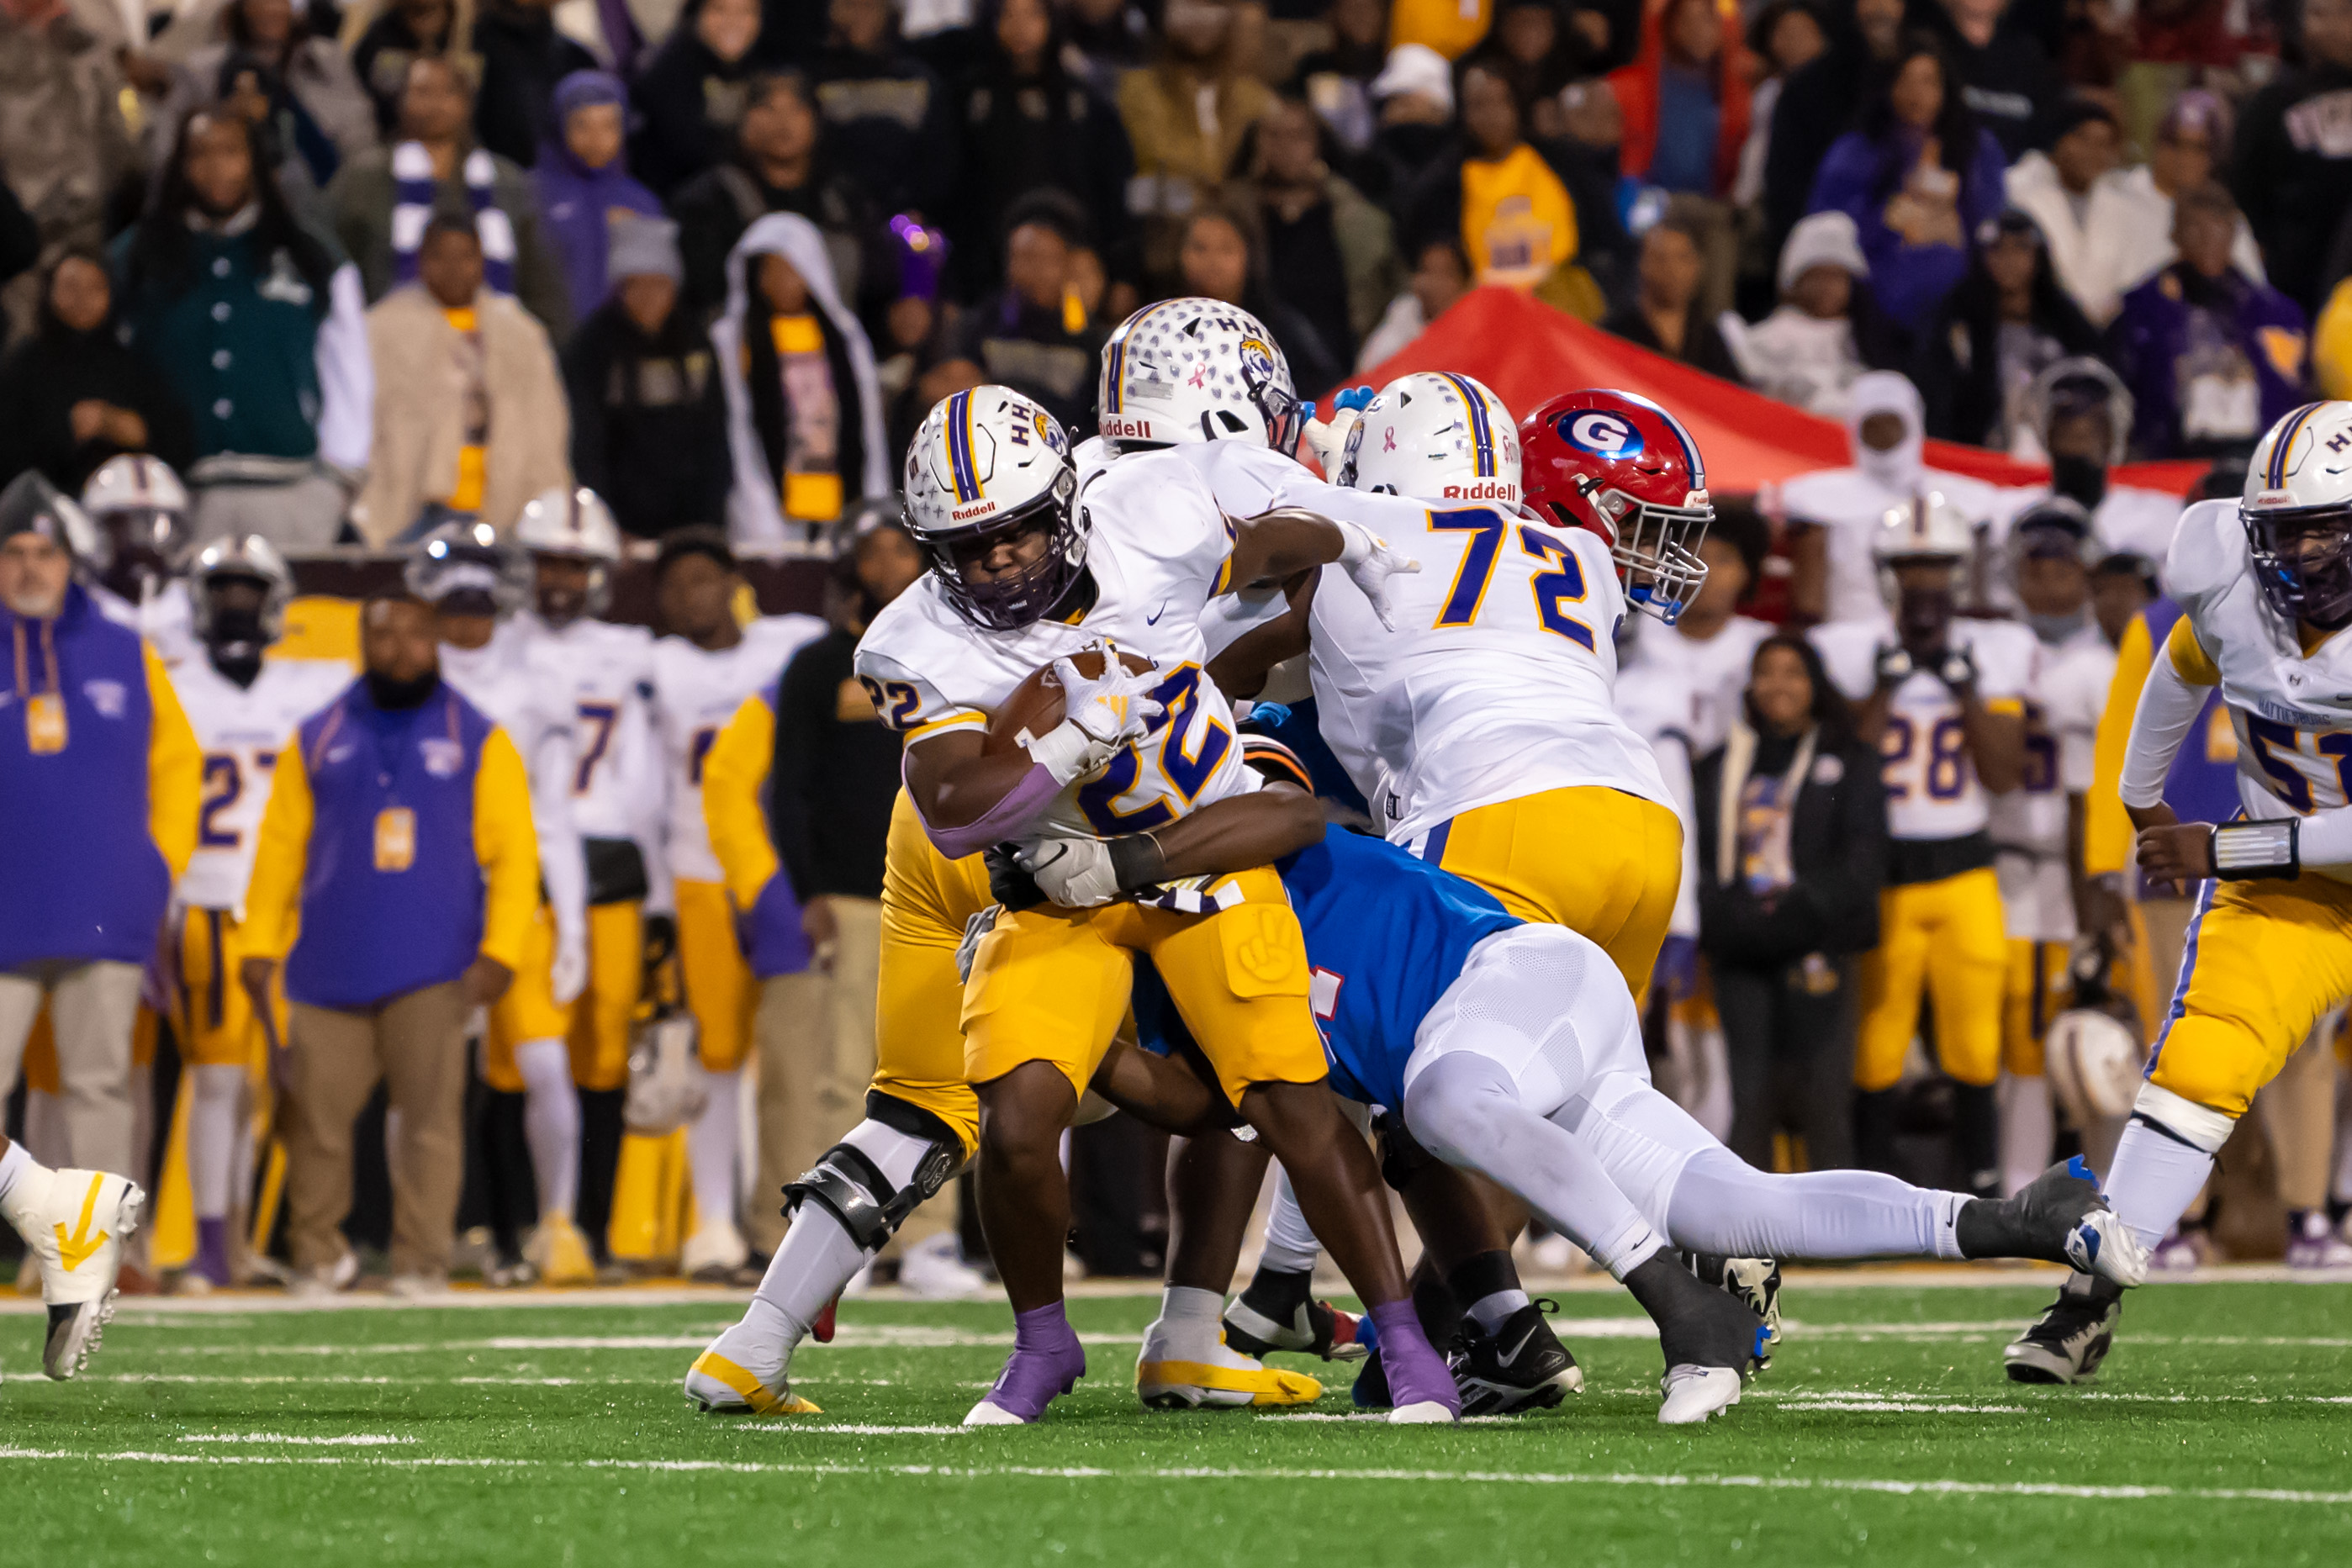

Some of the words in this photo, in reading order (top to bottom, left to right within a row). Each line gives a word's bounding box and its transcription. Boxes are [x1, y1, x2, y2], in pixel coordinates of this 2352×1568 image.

[1572, 414, 1629, 451] G
[952, 501, 996, 521] Riddell
[1443, 482, 1516, 502] Riddell
[1424, 504, 1597, 654] 72
[570, 700, 621, 795] 7
[1076, 660, 1232, 839] 22
[198, 752, 278, 849] 2
